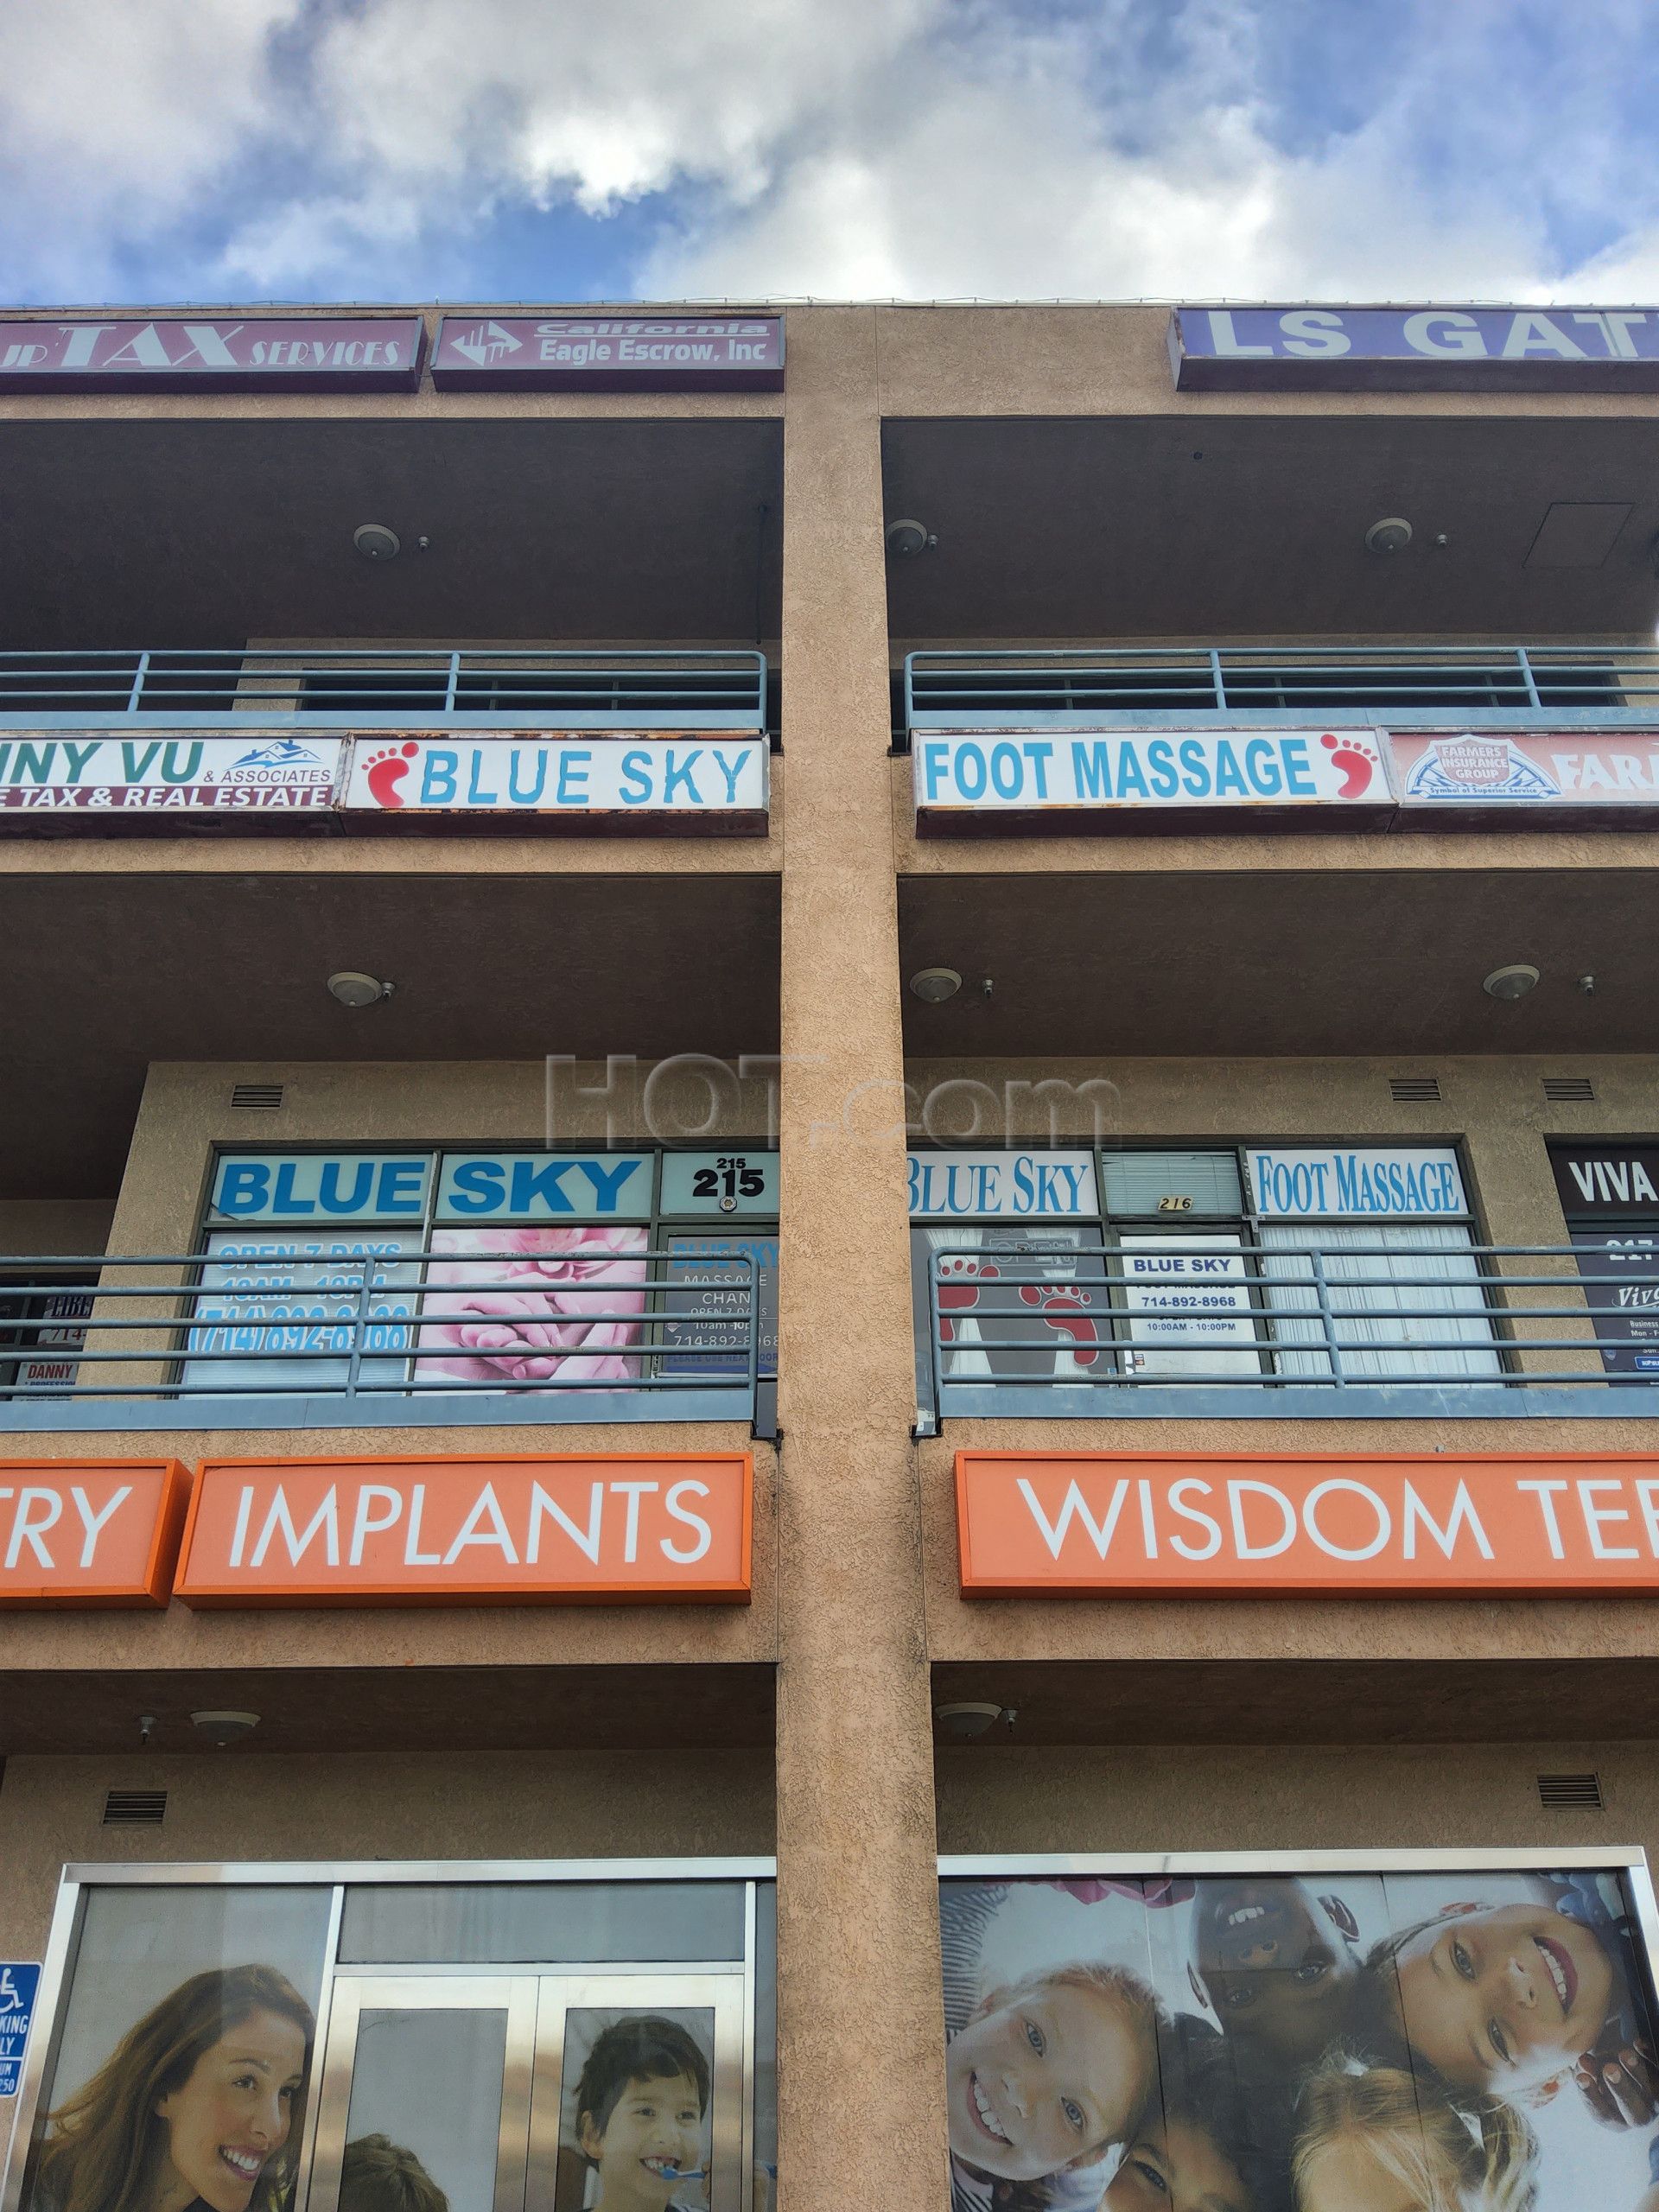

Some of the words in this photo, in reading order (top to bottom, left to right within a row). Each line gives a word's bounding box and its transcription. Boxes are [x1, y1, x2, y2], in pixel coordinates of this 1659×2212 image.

[537, 323, 767, 334] California
[1403, 312, 1659, 358] GAT
[57, 323, 244, 366] TAX
[250, 340, 399, 365] SERVICES
[540, 339, 611, 365] Eagle
[618, 339, 721, 361] Escrow,
[728, 339, 767, 360] Inc
[121, 741, 205, 783] VU
[204, 771, 214, 782] &
[220, 769, 331, 783] ASSOCIATES
[1441, 747, 1501, 757] FARMERS
[1442, 758, 1508, 768] INSURANCE
[420, 750, 592, 804] BLUE
[619, 749, 752, 804] SKY
[925, 742, 1053, 801] FOOT
[1071, 738, 1319, 798] MASSAGE
[1455, 769, 1499, 779] GROUP
[20, 788, 82, 806] TAX
[87, 787, 113, 806] &
[124, 787, 205, 806] REAL
[214, 786, 329, 805] ESTATE
[717, 1158, 746, 1169] 215
[219, 1162, 425, 1213] BLUE
[448, 1161, 642, 1213] SKY
[693, 1169, 765, 1197] 215
[1014, 1156, 1089, 1213] SKY
[1256, 1156, 1329, 1212] FOOT
[1333, 1155, 1459, 1212] MASSAGE
[1568, 1162, 1658, 1202] VIVA
[1160, 1198, 1192, 1209] 216
[217, 1243, 298, 1269] OPEN
[327, 1243, 403, 1268] DAYS
[674, 1243, 730, 1268] BLUE
[1606, 1240, 1653, 1261] 217
[1134, 1259, 1185, 1272] BLUE
[1192, 1259, 1230, 1272] SKY
[684, 1274, 767, 1287] MASSAE
[1141, 1297, 1236, 1306] 714-892-8968
[27, 1364, 72, 1379] DANNY
[228, 1480, 711, 1567] IMPLANTS
[1016, 1478, 1495, 1560] WISDOM
